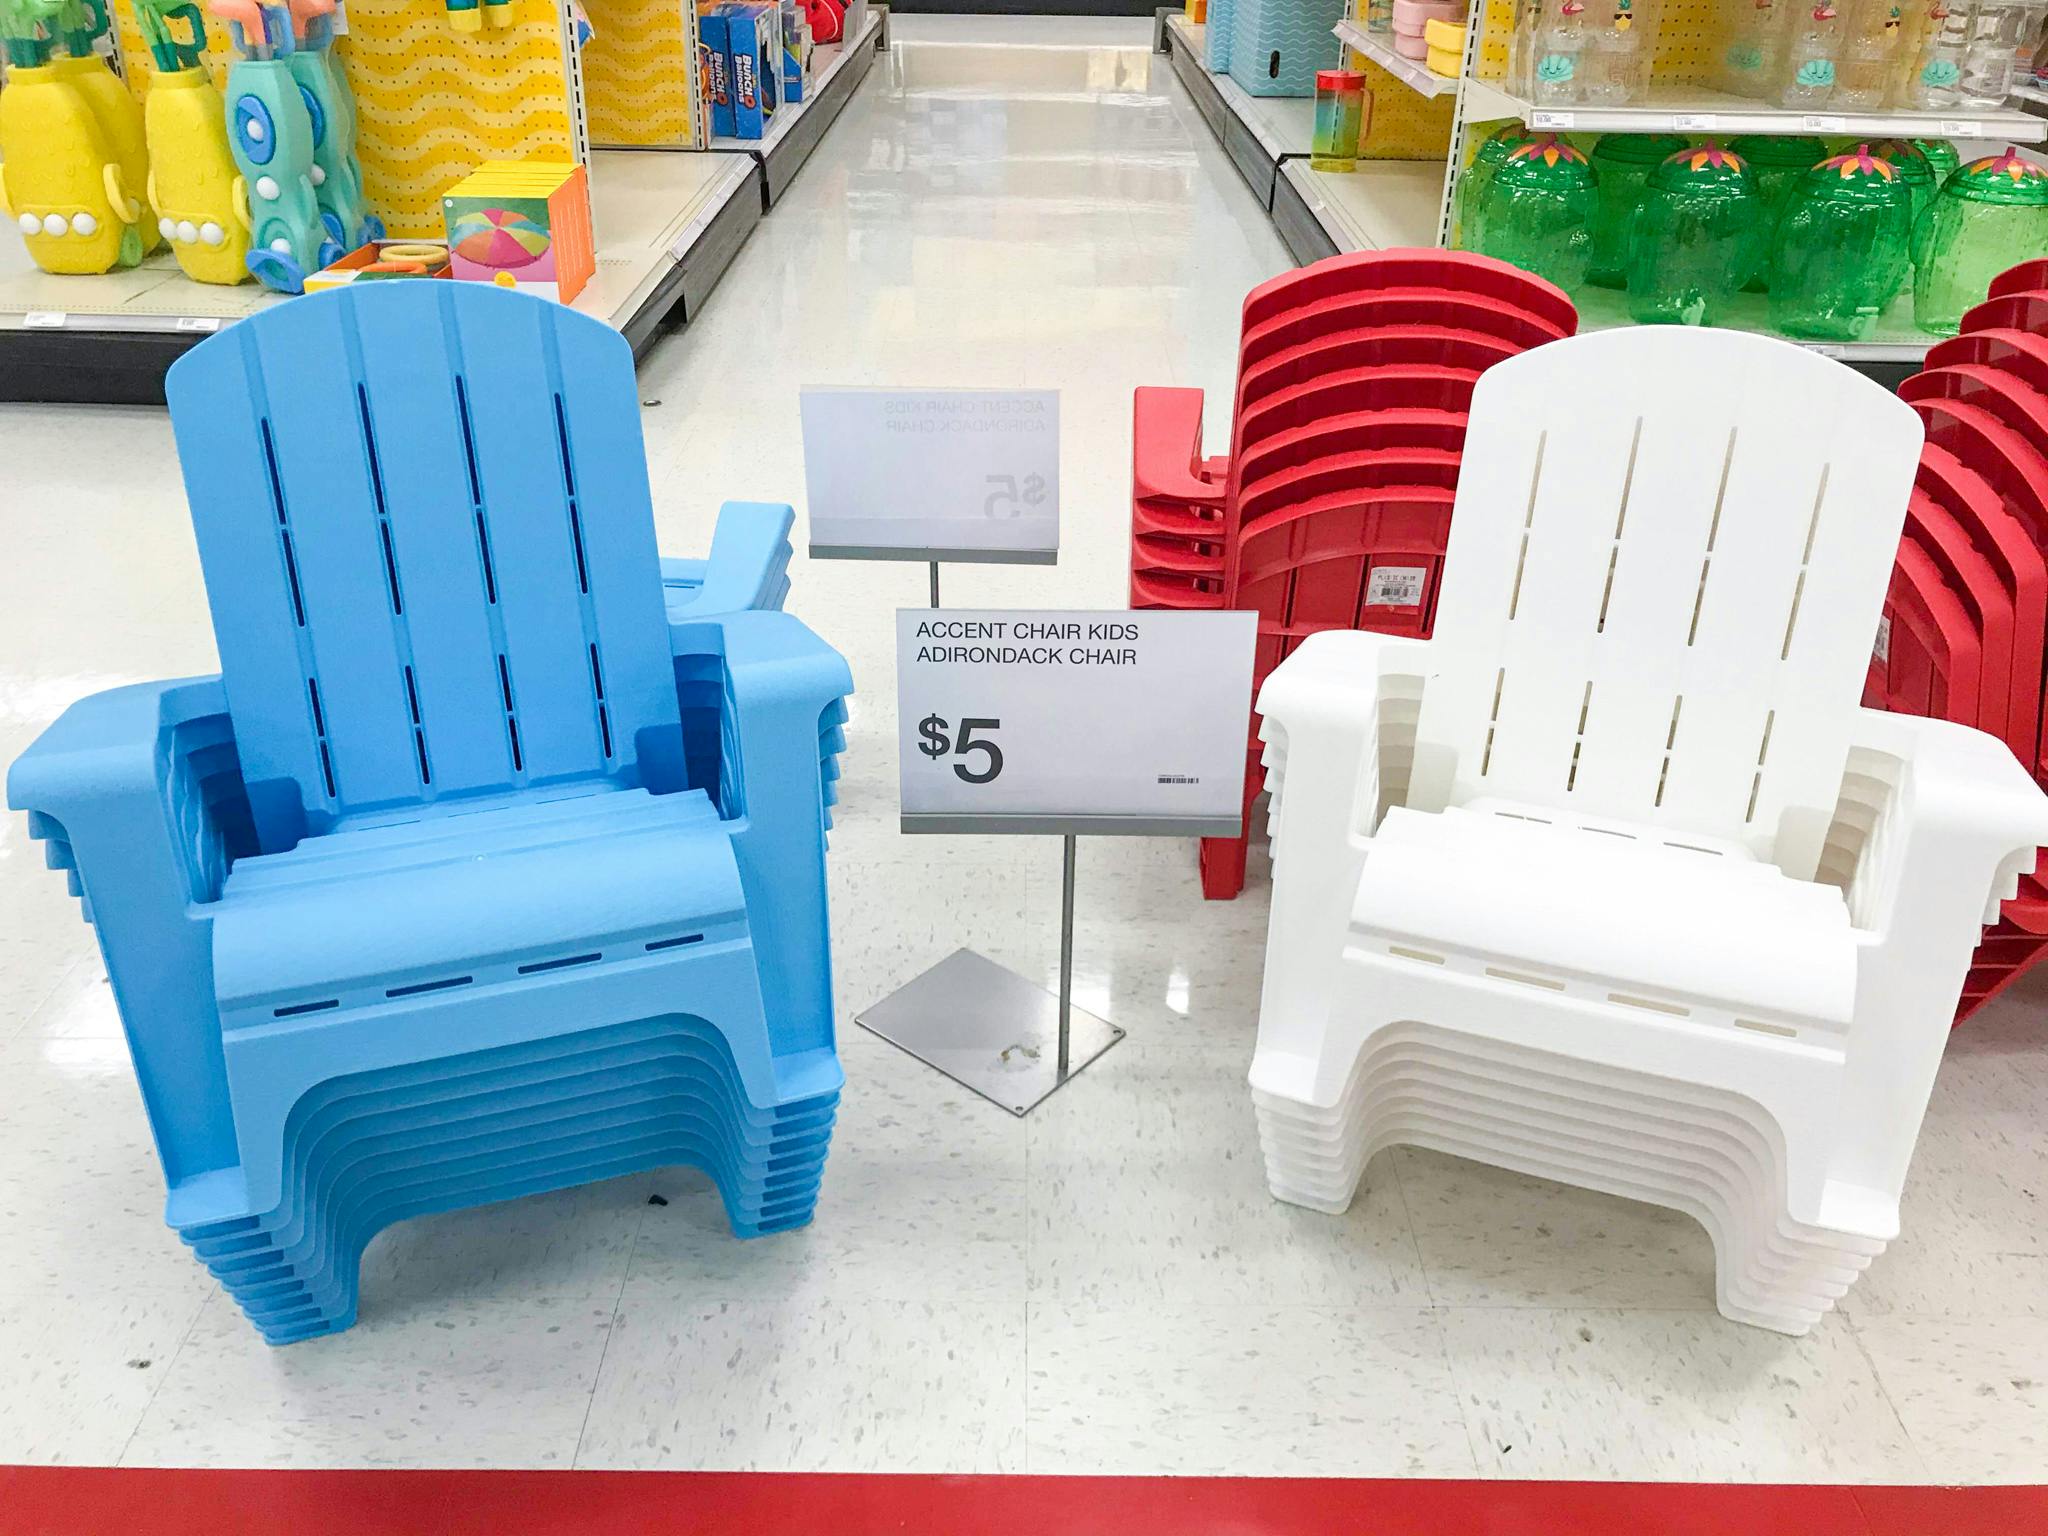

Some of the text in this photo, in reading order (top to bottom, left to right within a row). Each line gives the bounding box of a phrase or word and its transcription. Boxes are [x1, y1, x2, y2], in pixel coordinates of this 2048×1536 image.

[734, 55, 745, 103] Balloons
[916, 622, 1139, 640] ACCENT CHAIR KIDS
[916, 646, 1137, 665] ADIRONDACK CHAIR
[918, 713, 1003, 784] $5
